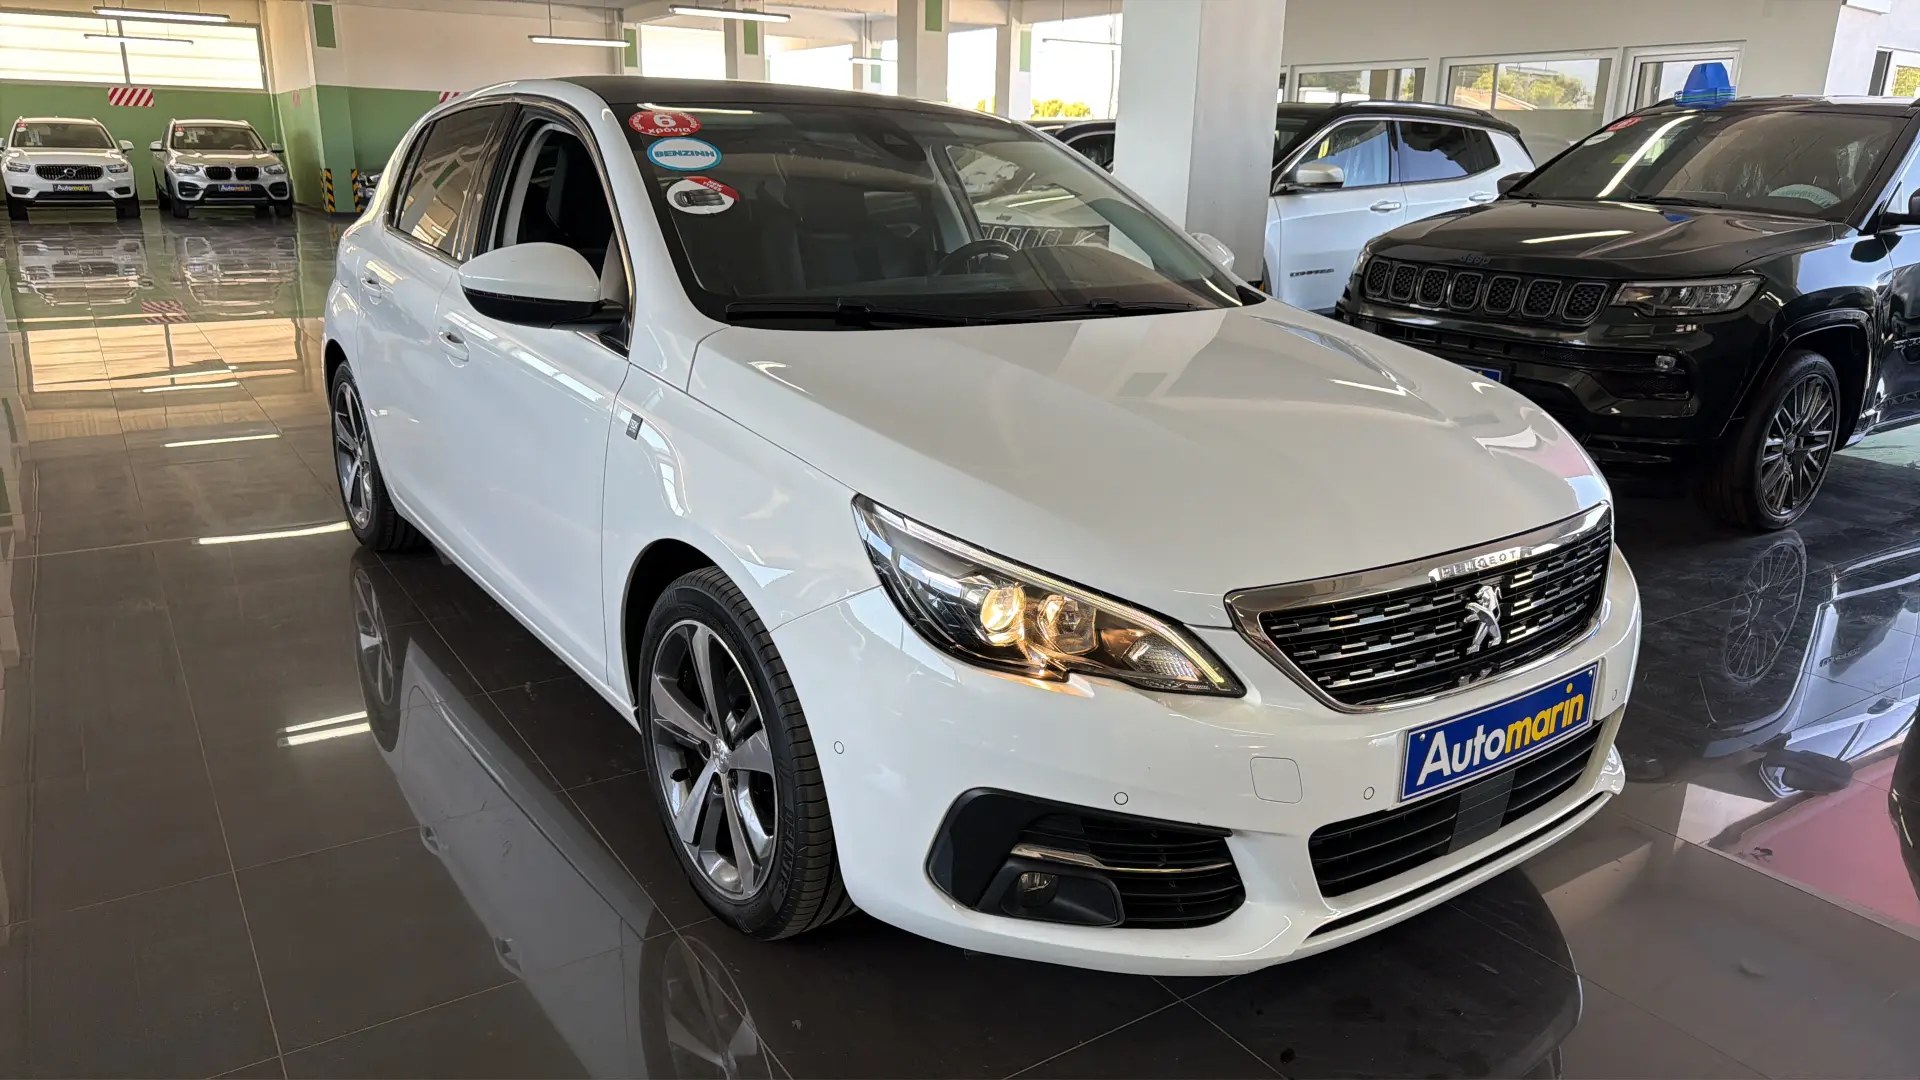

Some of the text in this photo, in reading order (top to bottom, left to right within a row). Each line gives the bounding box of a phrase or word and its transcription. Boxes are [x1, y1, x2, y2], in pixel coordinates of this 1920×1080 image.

[648, 126, 692, 135] χρόνια
[653, 114, 677, 128] 6
[1441, 550, 1516, 578] PEUGEOT
[1416, 683, 1584, 786] Automarin
